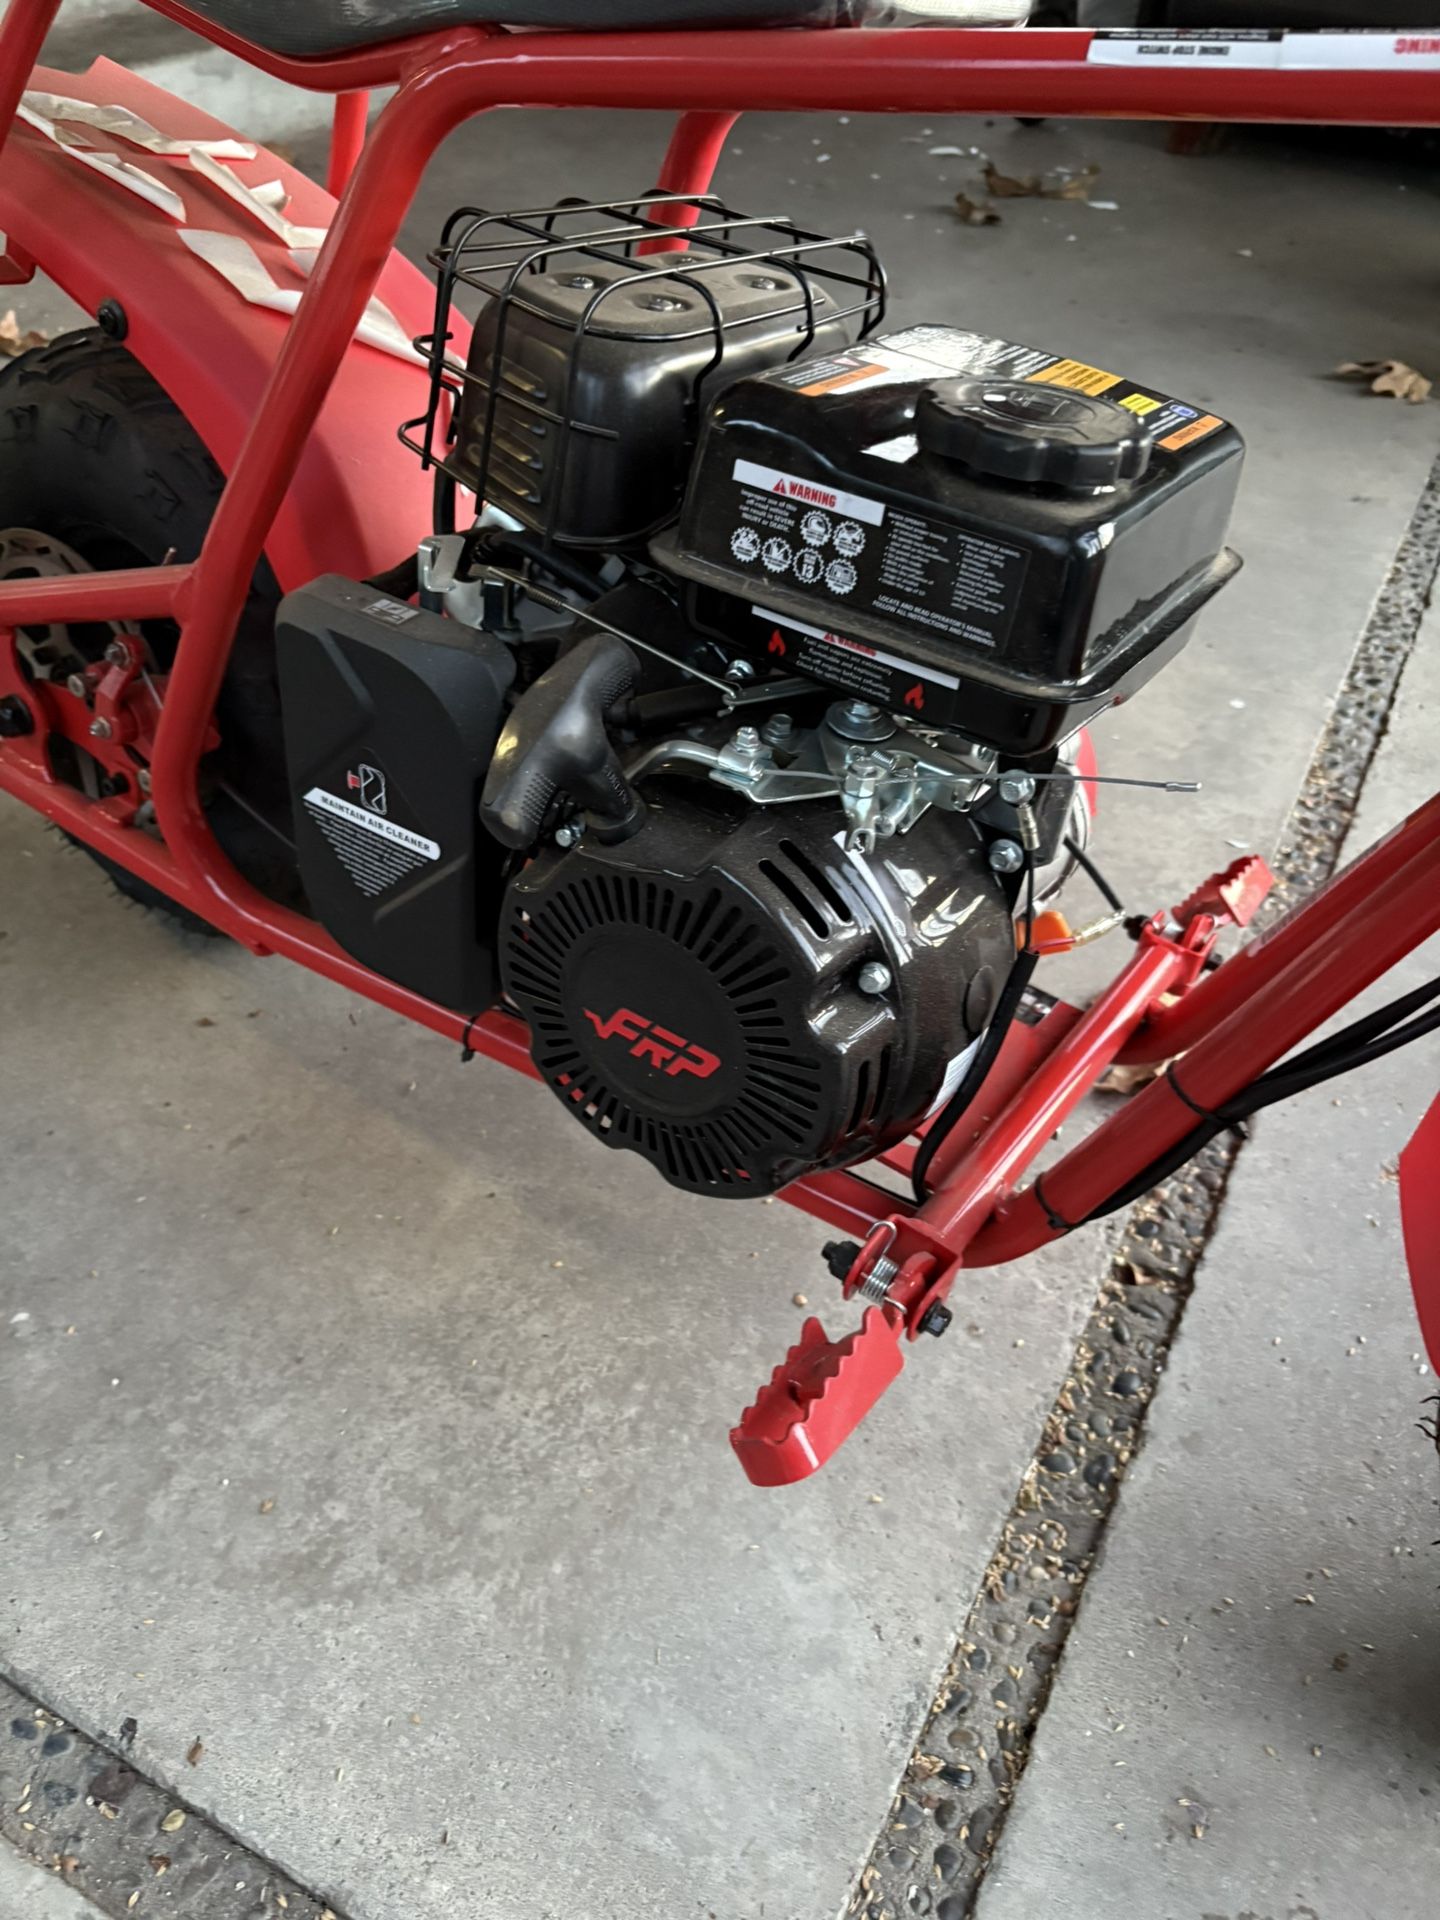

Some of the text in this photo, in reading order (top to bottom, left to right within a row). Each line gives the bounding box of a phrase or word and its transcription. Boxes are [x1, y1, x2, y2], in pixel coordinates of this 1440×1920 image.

[788, 481, 837, 508] WARNING
[321, 796, 431, 853] MAINTAIN AIR CLEANER
